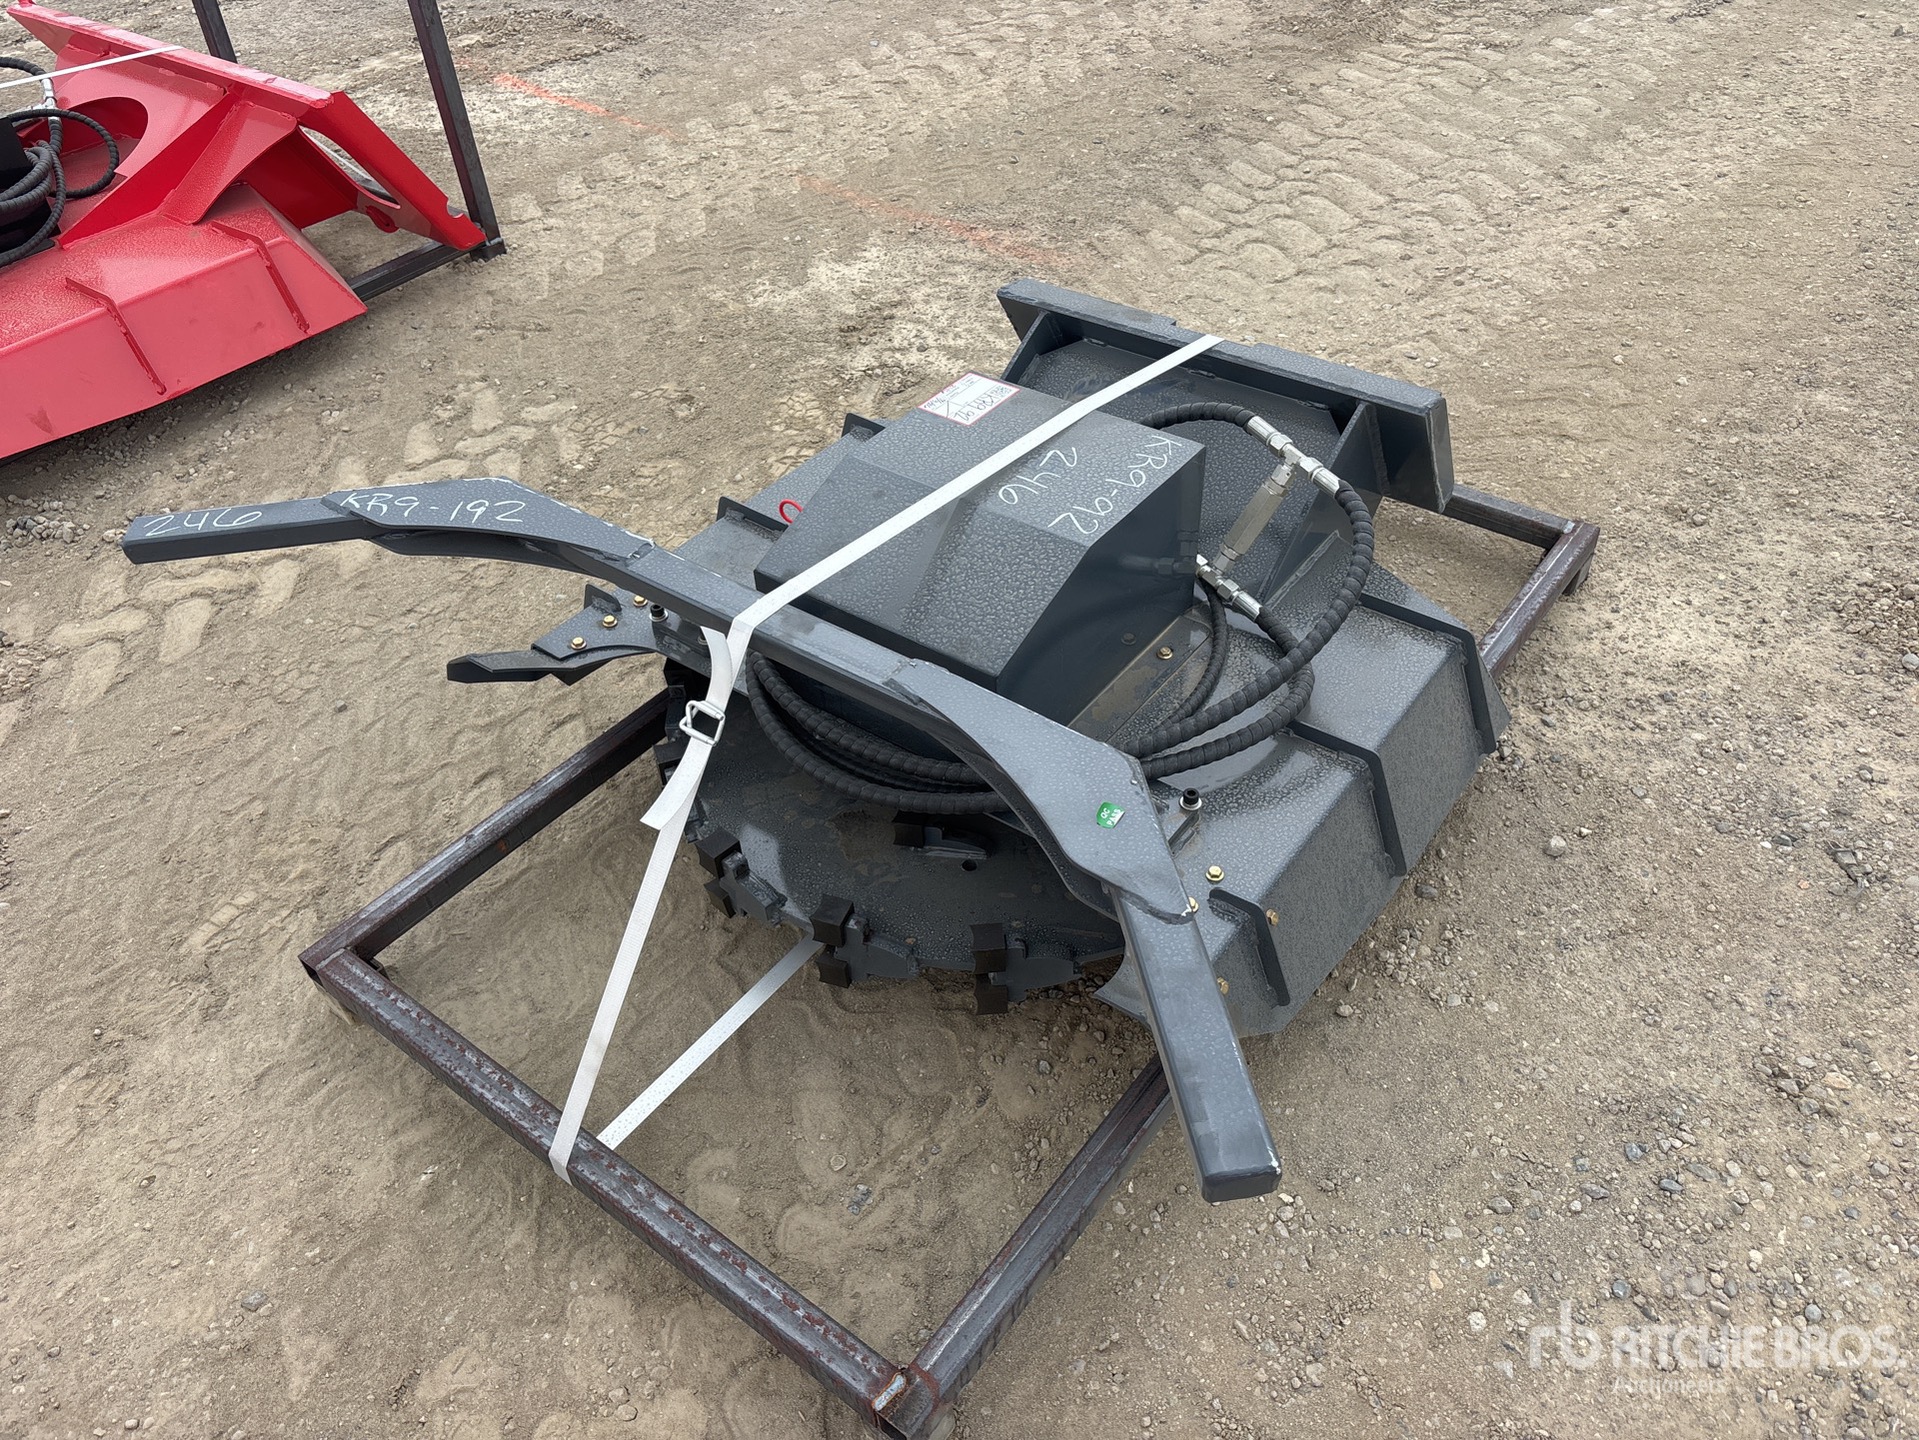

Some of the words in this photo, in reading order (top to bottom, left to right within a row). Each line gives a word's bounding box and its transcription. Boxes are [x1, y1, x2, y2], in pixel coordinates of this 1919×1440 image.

[998, 446, 1078, 505] 246
[1047, 434, 1182, 534] KR9-92
[143, 508, 264, 539] 246
[340, 492, 529, 525] KR9-192
[1100, 808, 1110, 818] QC
